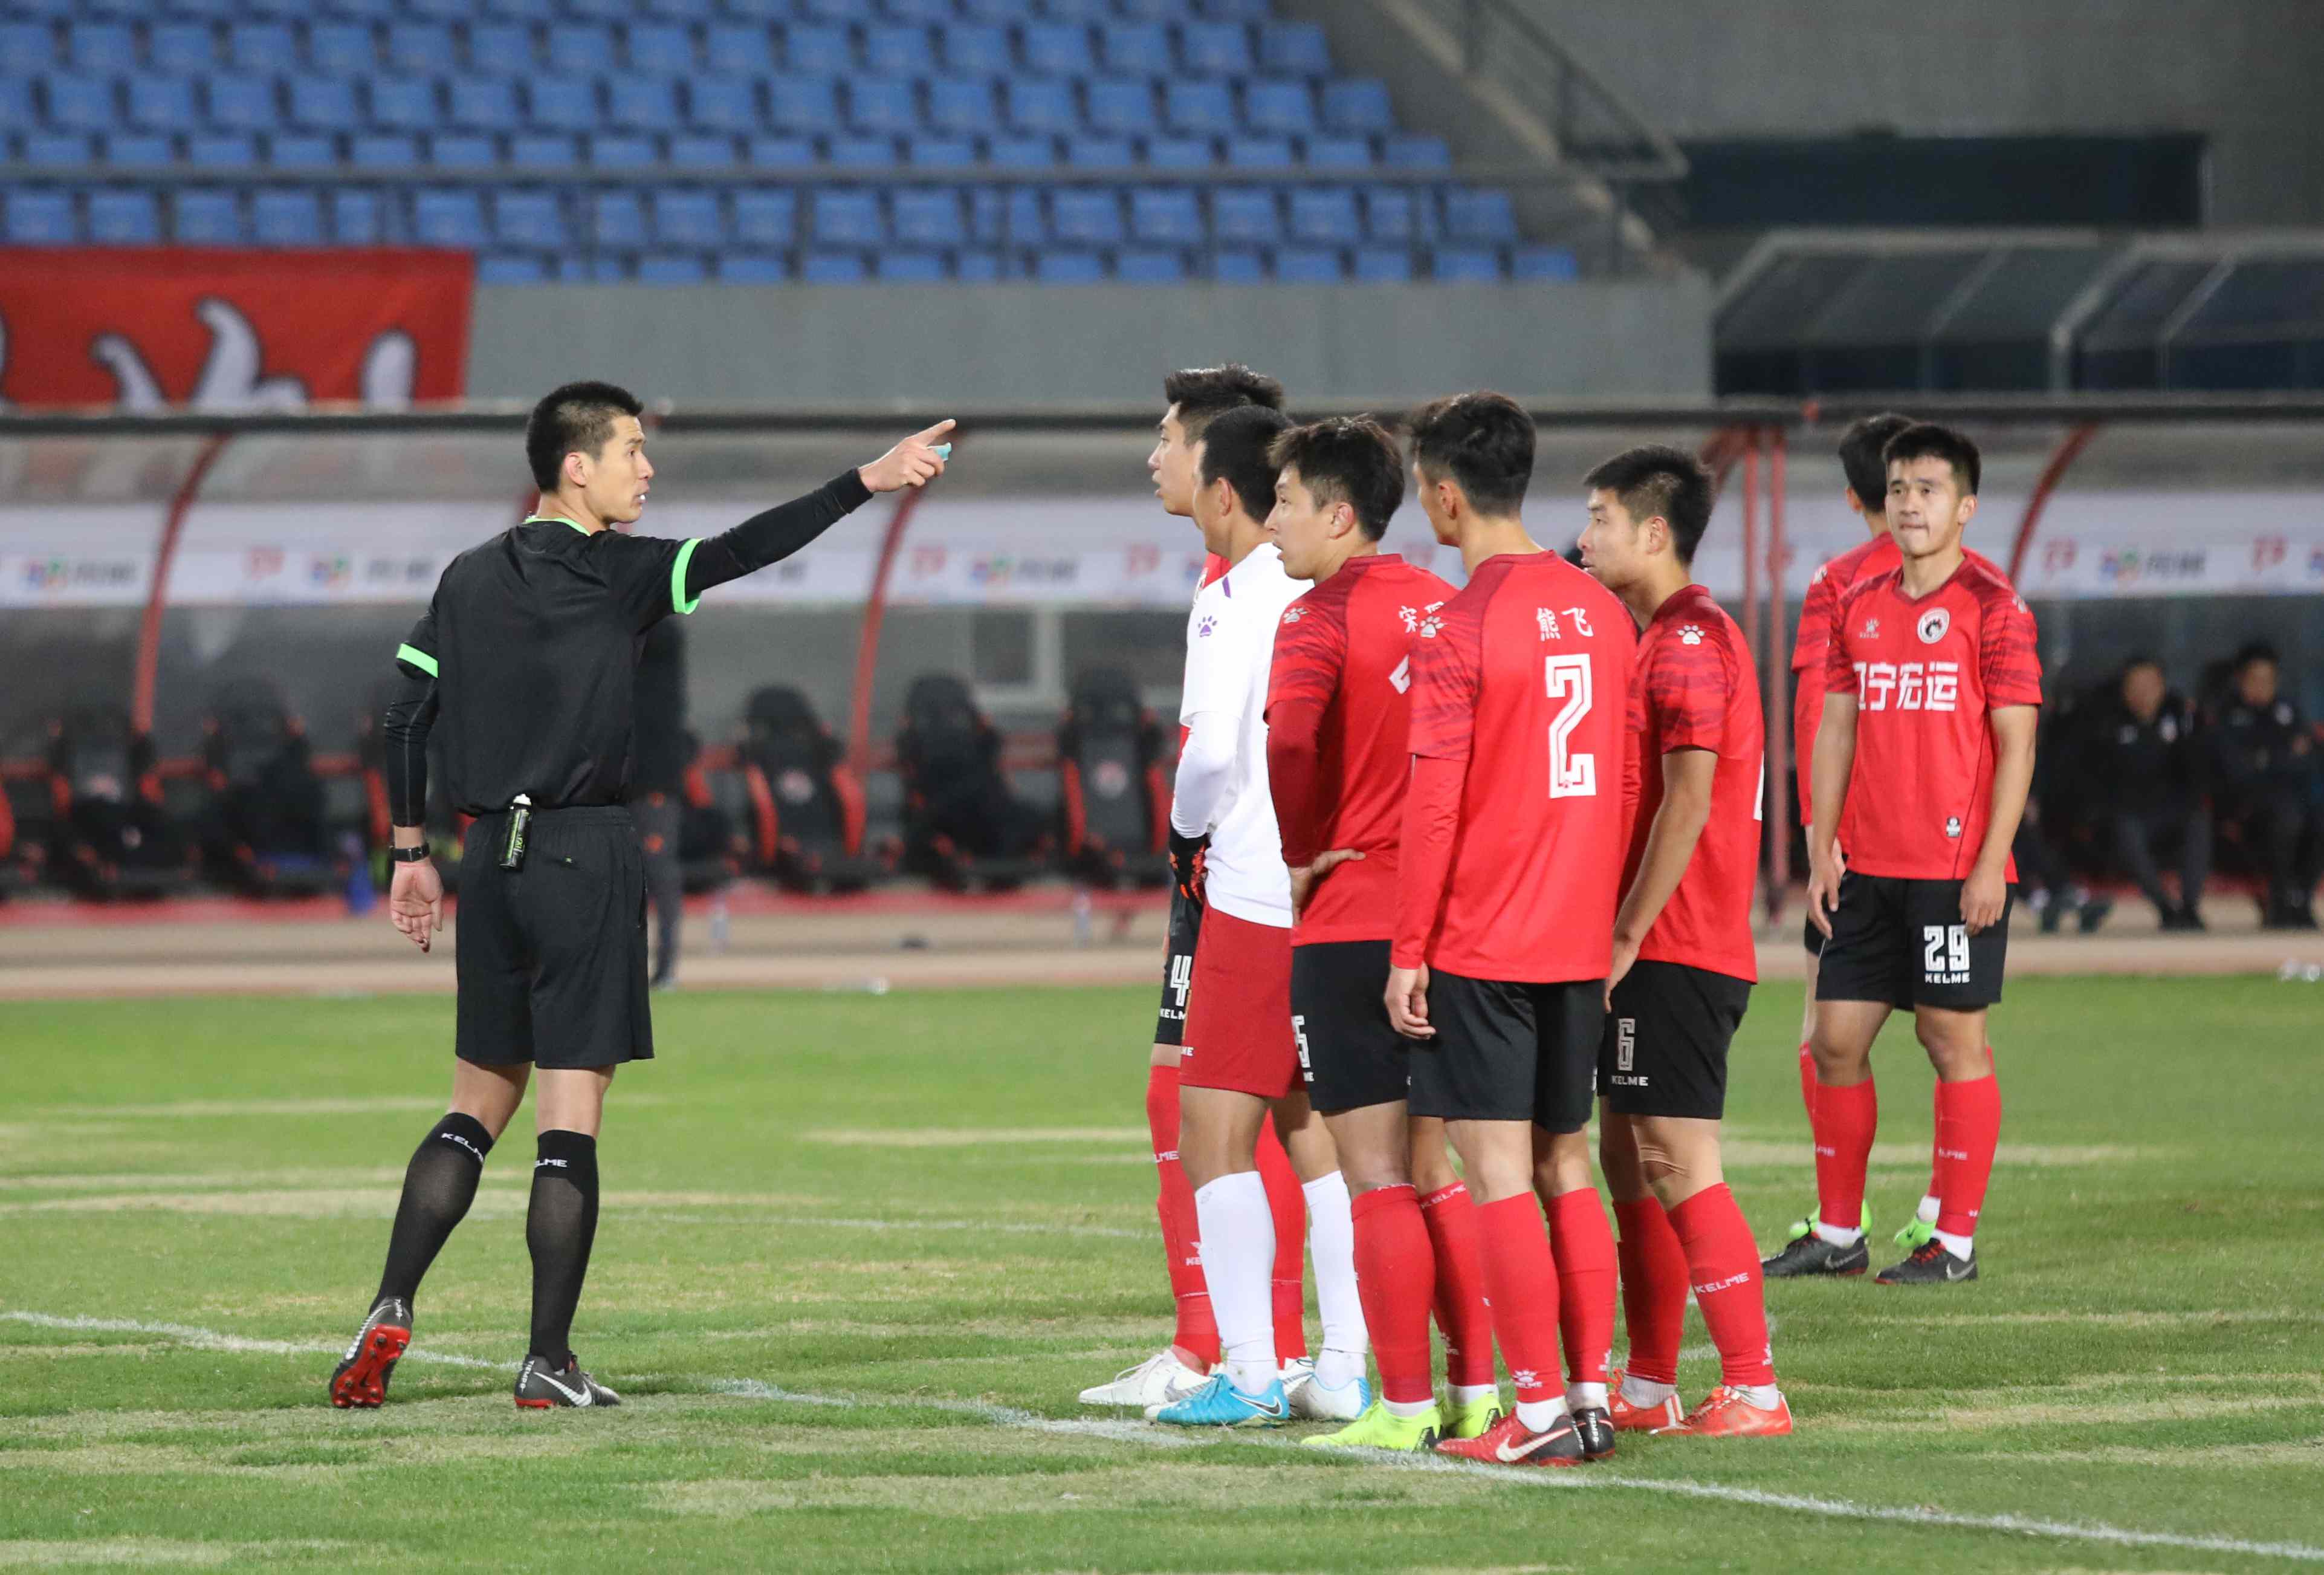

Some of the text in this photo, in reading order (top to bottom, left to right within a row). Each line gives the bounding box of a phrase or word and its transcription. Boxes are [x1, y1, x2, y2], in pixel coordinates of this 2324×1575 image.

[1536, 607, 1594, 641] 熊飞
[1545, 653, 1597, 799] 2
[1924, 925, 1970, 972] 29
[1170, 955, 1193, 1007] 4
[1924, 972, 1970, 984] KELME
[1291, 1015, 1311, 1068] 5
[1617, 1018, 1636, 1071] 6
[1611, 1075, 1649, 1086] KELME
[1694, 1272, 1750, 1294] KELME
